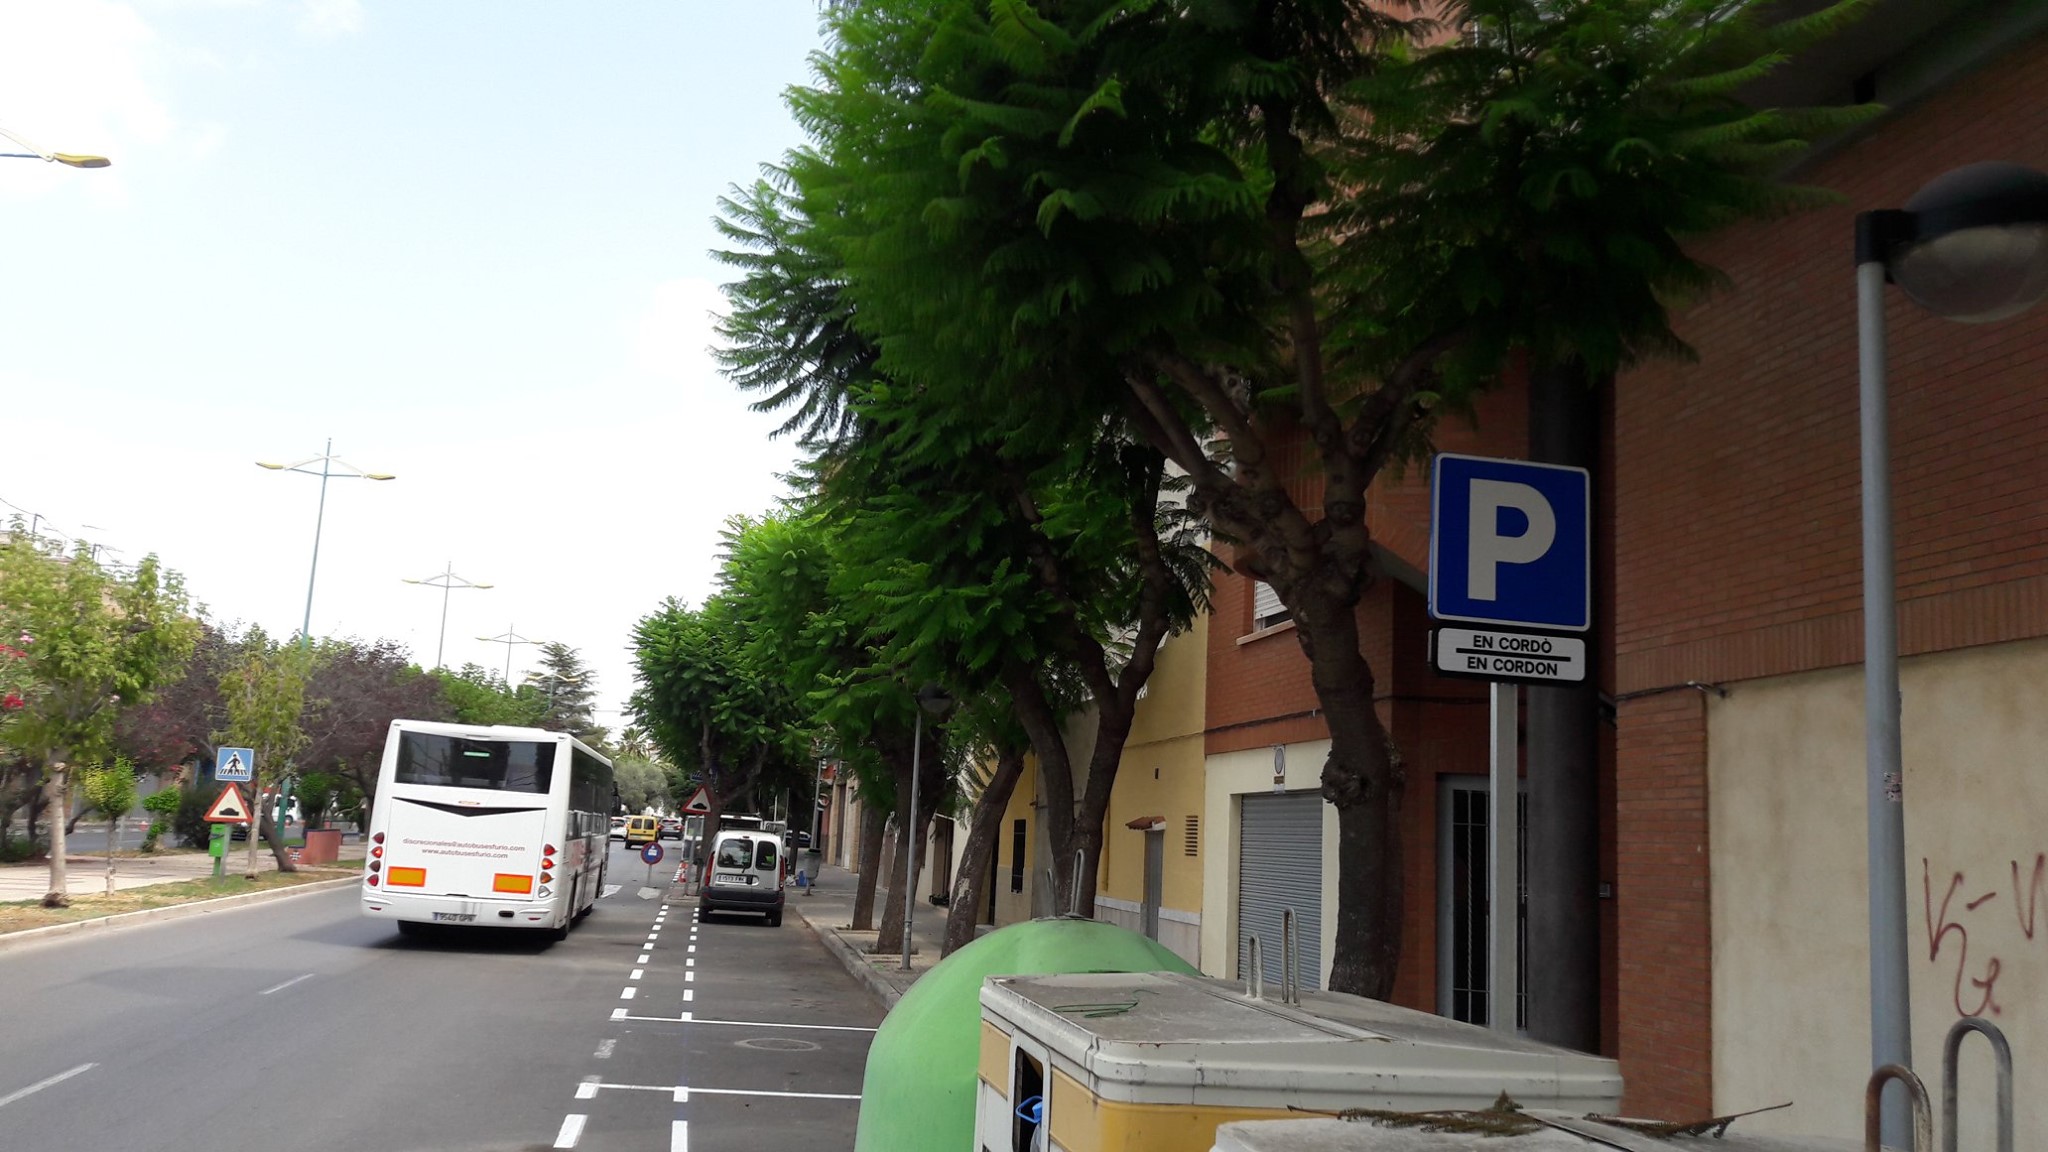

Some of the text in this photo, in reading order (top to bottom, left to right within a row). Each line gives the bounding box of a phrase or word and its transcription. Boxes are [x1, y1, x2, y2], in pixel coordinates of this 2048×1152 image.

[1467, 477, 1557, 602] P
[1473, 634, 1553, 654] EN CORDÒ
[1467, 656, 1558, 676] EN CORDON
